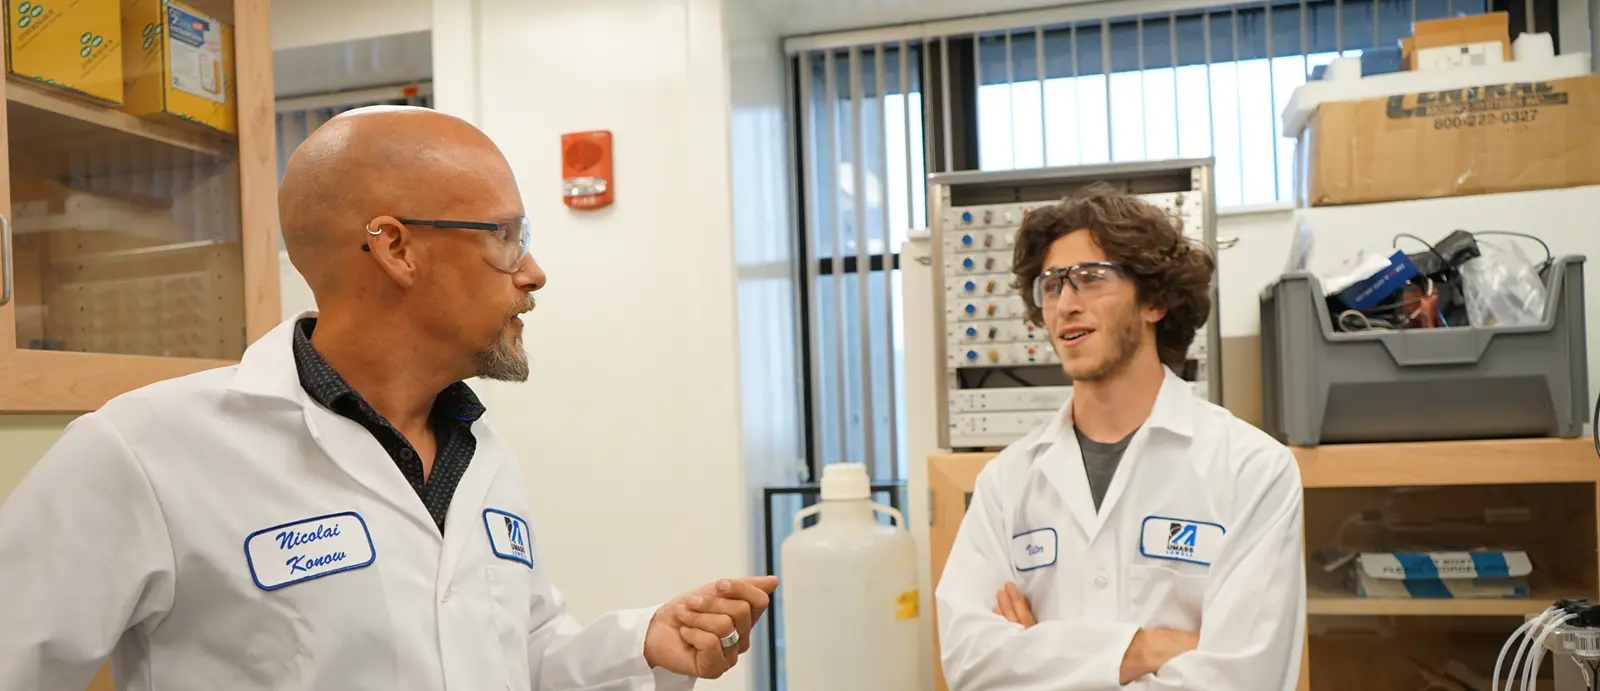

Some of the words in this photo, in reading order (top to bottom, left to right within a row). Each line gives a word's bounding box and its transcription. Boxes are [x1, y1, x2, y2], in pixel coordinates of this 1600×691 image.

[275, 523, 341, 550] Nicolai
[1167, 544, 1194, 553] UMASS
[286, 551, 347, 575] Konow
